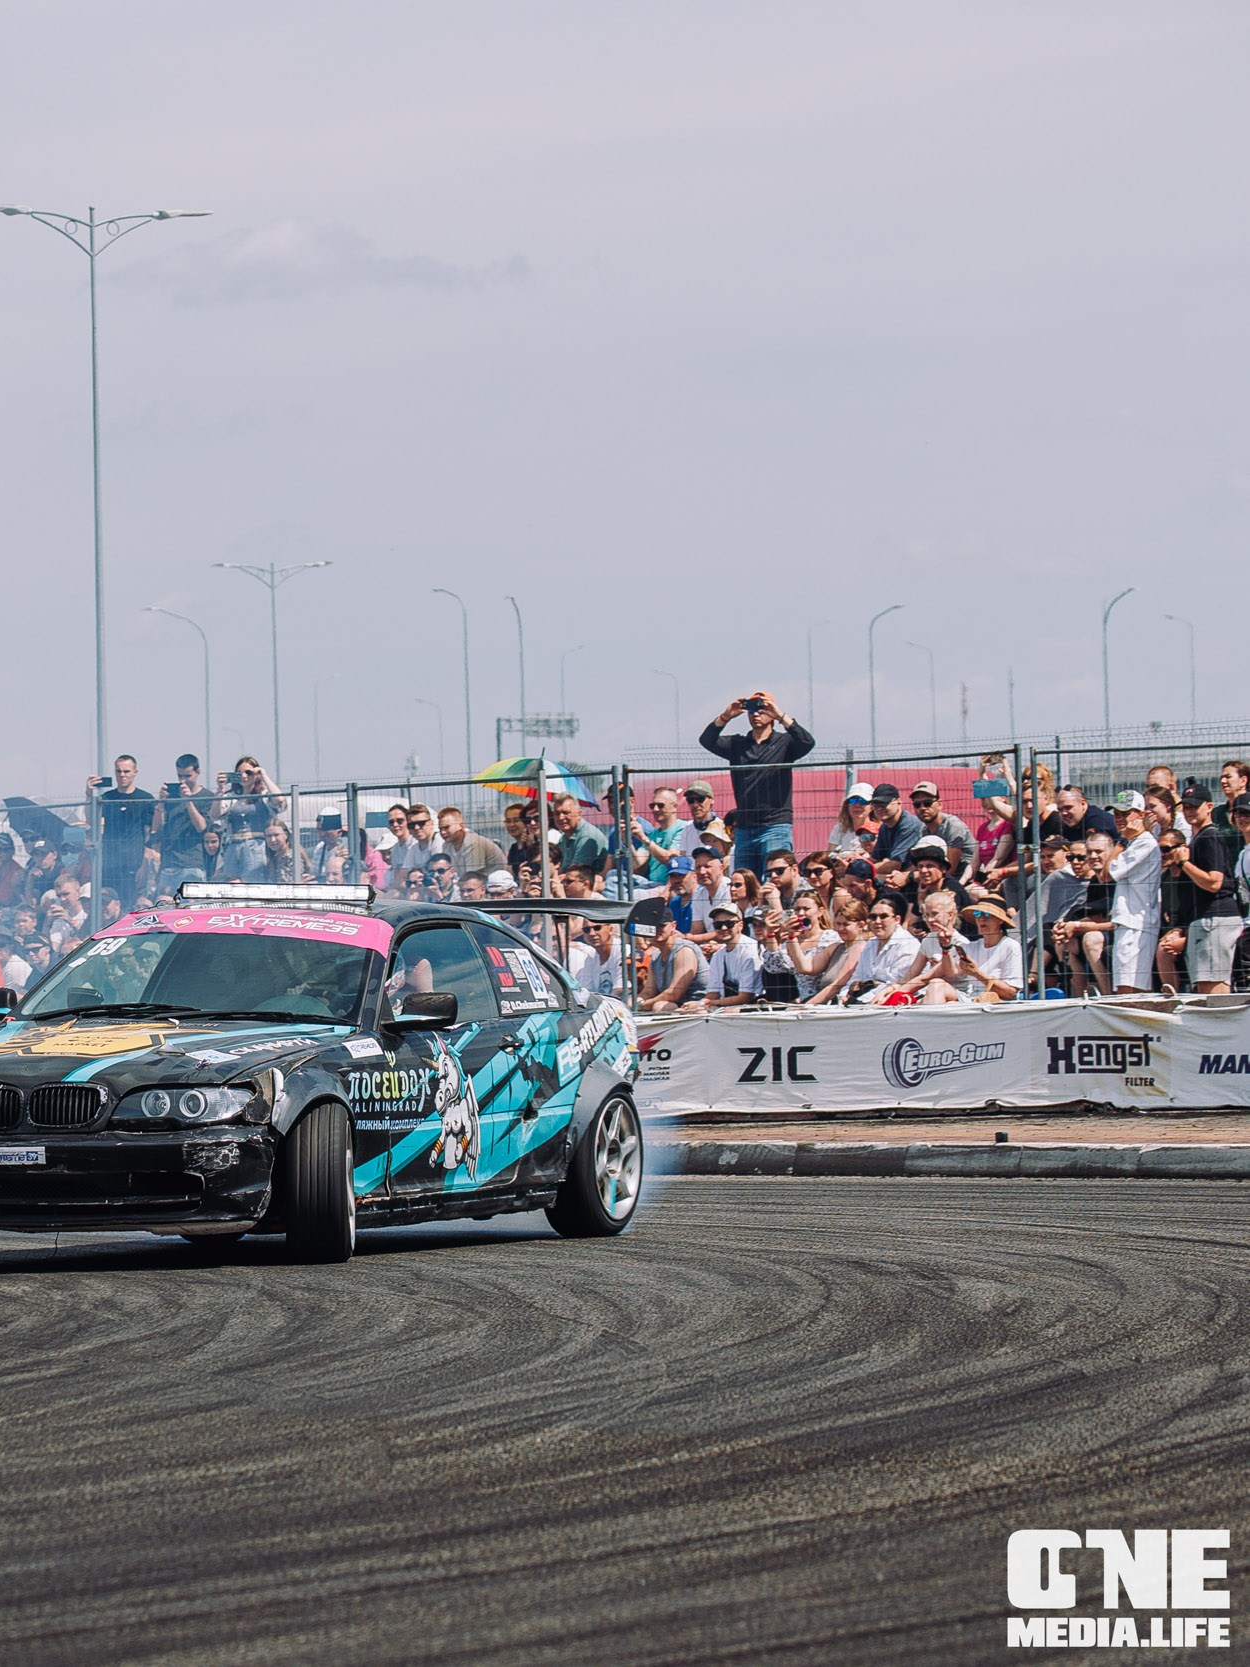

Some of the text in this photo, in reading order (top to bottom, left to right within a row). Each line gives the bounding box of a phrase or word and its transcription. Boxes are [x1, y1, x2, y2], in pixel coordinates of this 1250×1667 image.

[206, 913, 359, 935] EXTREME39
[87, 938, 127, 956] 69
[522, 959, 544, 992] 69
[1047, 1034, 1154, 1074] Hengst
[735, 1046, 819, 1084] ZIC
[1125, 1077, 1155, 1086] FILTER
[350, 1101, 417, 1113] ALININGRAD
[354, 1116, 390, 1130] ЛЯЖНЫЙ
